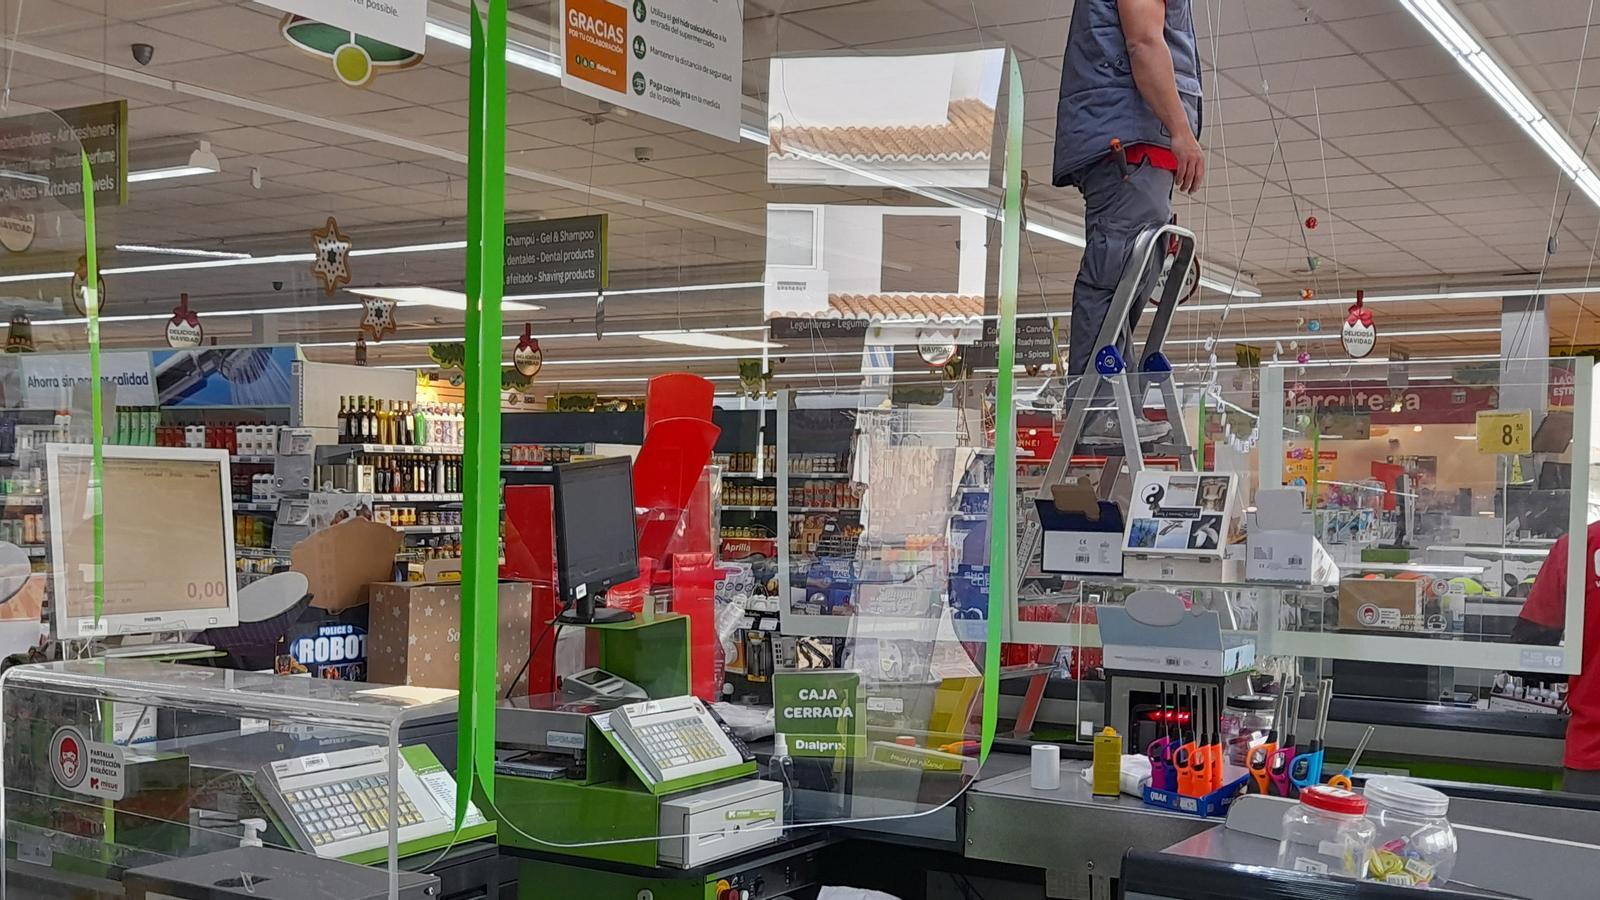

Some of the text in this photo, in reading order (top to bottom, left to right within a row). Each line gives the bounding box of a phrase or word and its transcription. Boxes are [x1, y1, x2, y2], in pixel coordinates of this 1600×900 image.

[568, 8, 624, 44] GRACIAS
[650, 19, 670, 32] entrada
[671, 25, 679, 35] del
[672, 16, 680, 25] gel
[568, 28, 578, 38] POR
[650, 45, 674, 60] Mantener
[680, 57, 702, 71] distancia
[649, 79, 662, 91] Paga
[663, 84, 673, 93] con
[673, 86, 691, 99] tarjeta
[703, 98, 721, 110] medida
[44, 179, 81, 197] Kitchen
[505, 233, 535, 248] Champú
[540, 231, 552, 243] Gel
[560, 229, 594, 243] Shampoo
[507, 253, 536, 266] dentales
[540, 250, 563, 263] Dental
[563, 248, 594, 263] products
[506, 271, 534, 285] afeitado
[538, 269, 564, 284] Shaving
[565, 268, 595, 283] products
[790, 320, 831, 331] Legumbres
[169, 329, 200, 337] DELICIOSA
[1343, 330, 1374, 338] DELICIOSA
[170, 336, 199, 345] NAVIDAD
[1034, 337, 1051, 346] meals
[1028, 350, 1050, 359] Spices
[27, 375, 59, 388] Ahorra
[62, 374, 76, 387] sin
[113, 371, 149, 386] calidad
[1502, 424, 1513, 446] 8
[187, 581, 225, 600] 0,00
[320, 625, 346, 636] POLICE
[447, 627, 460, 642] So
[299, 634, 368, 664] ROBOT
[798, 688, 838, 701] CAJA
[783, 706, 854, 719] CERRADA
[795, 739, 846, 753] Dialprix
[90, 749, 115, 759] PANTALLA
[90, 758, 122, 769] PROTECCIÓN
[90, 767, 118, 777] BIOLÓGICA
